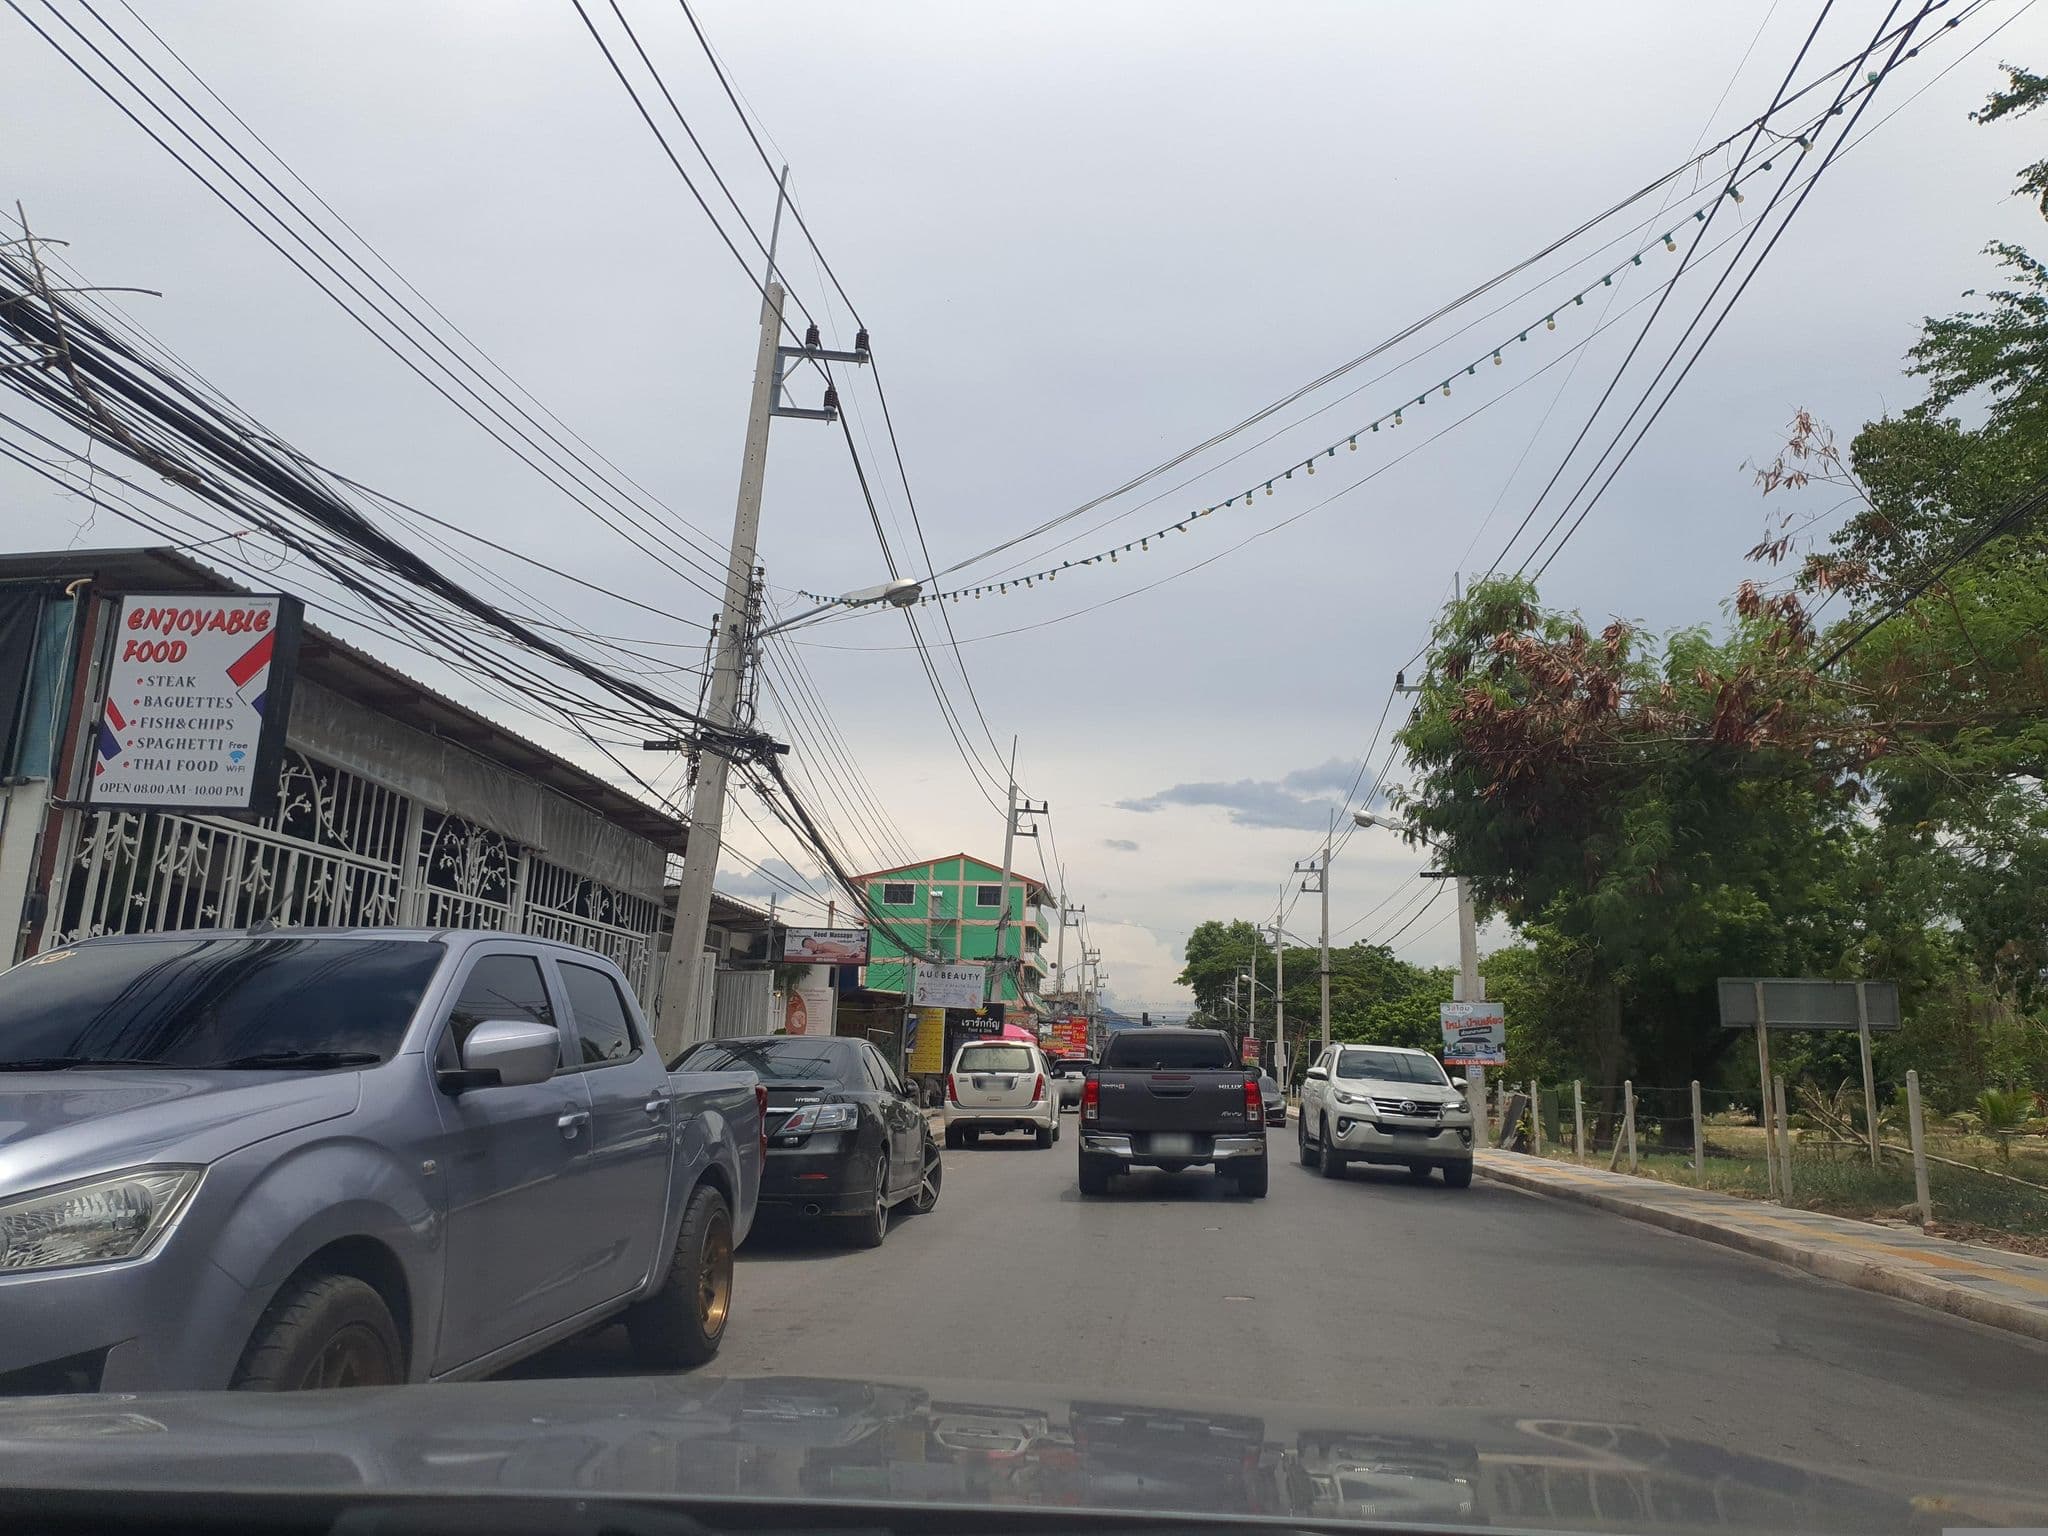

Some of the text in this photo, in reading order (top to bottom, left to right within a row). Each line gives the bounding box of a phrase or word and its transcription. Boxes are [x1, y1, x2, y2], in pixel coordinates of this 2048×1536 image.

[127, 608, 271, 637] ENJOYABLE
[122, 640, 188, 663] FOOD
[146, 675, 197, 688] STEAK
[143, 695, 234, 709] BAGUETTES
[140, 717, 234, 731] FISH&CHIPS
[136, 737, 223, 751] SPAGHETTI
[229, 741, 248, 749] Free
[133, 758, 219, 772] THAI FOOD
[99, 782, 131, 794] OPEN
[133, 783, 165, 794] 08.00
[166, 784, 186, 795] AM
[195, 785, 223, 796] 10.00
[225, 786, 244, 797] PM
[941, 971, 981, 981] BEAUTY
